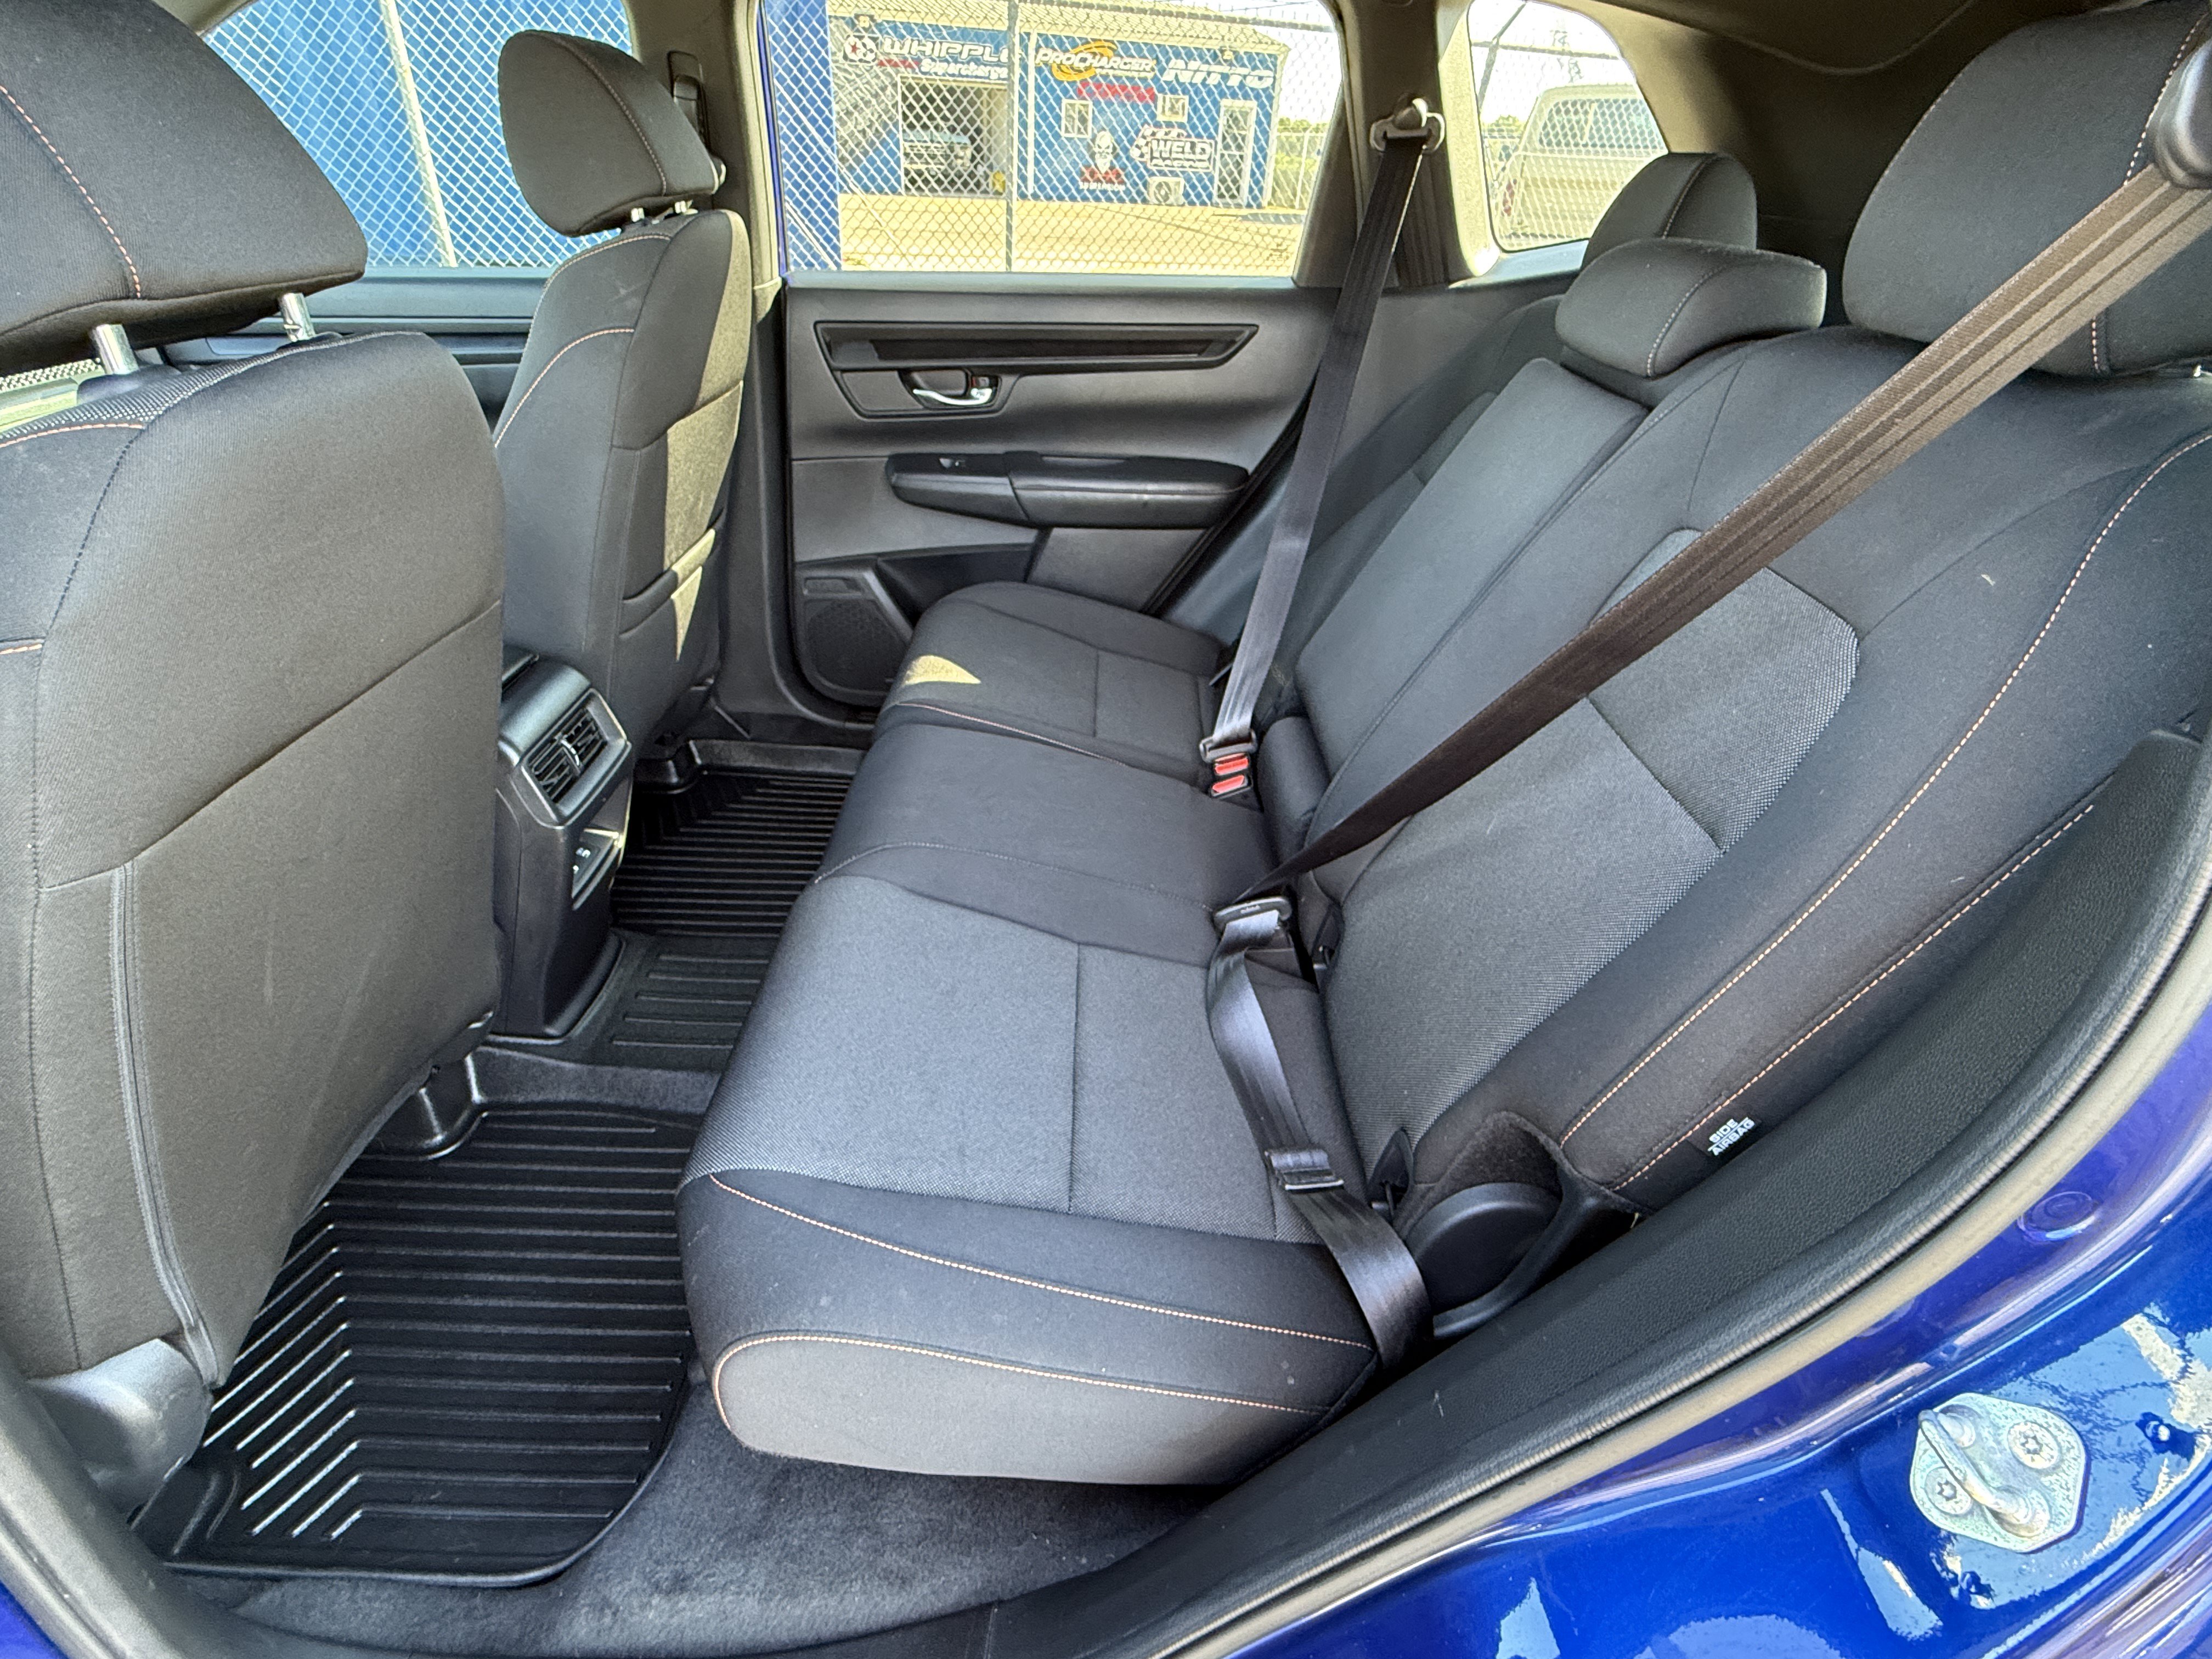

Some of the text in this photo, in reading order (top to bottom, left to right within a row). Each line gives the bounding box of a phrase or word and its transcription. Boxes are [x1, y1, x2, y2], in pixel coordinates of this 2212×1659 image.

[1162, 59, 1274, 88] NITTO
[1152, 139, 1211, 160] WELD
[1709, 1119, 1738, 1143] SIDE
[1712, 1119, 1754, 1156] AIRBAG
